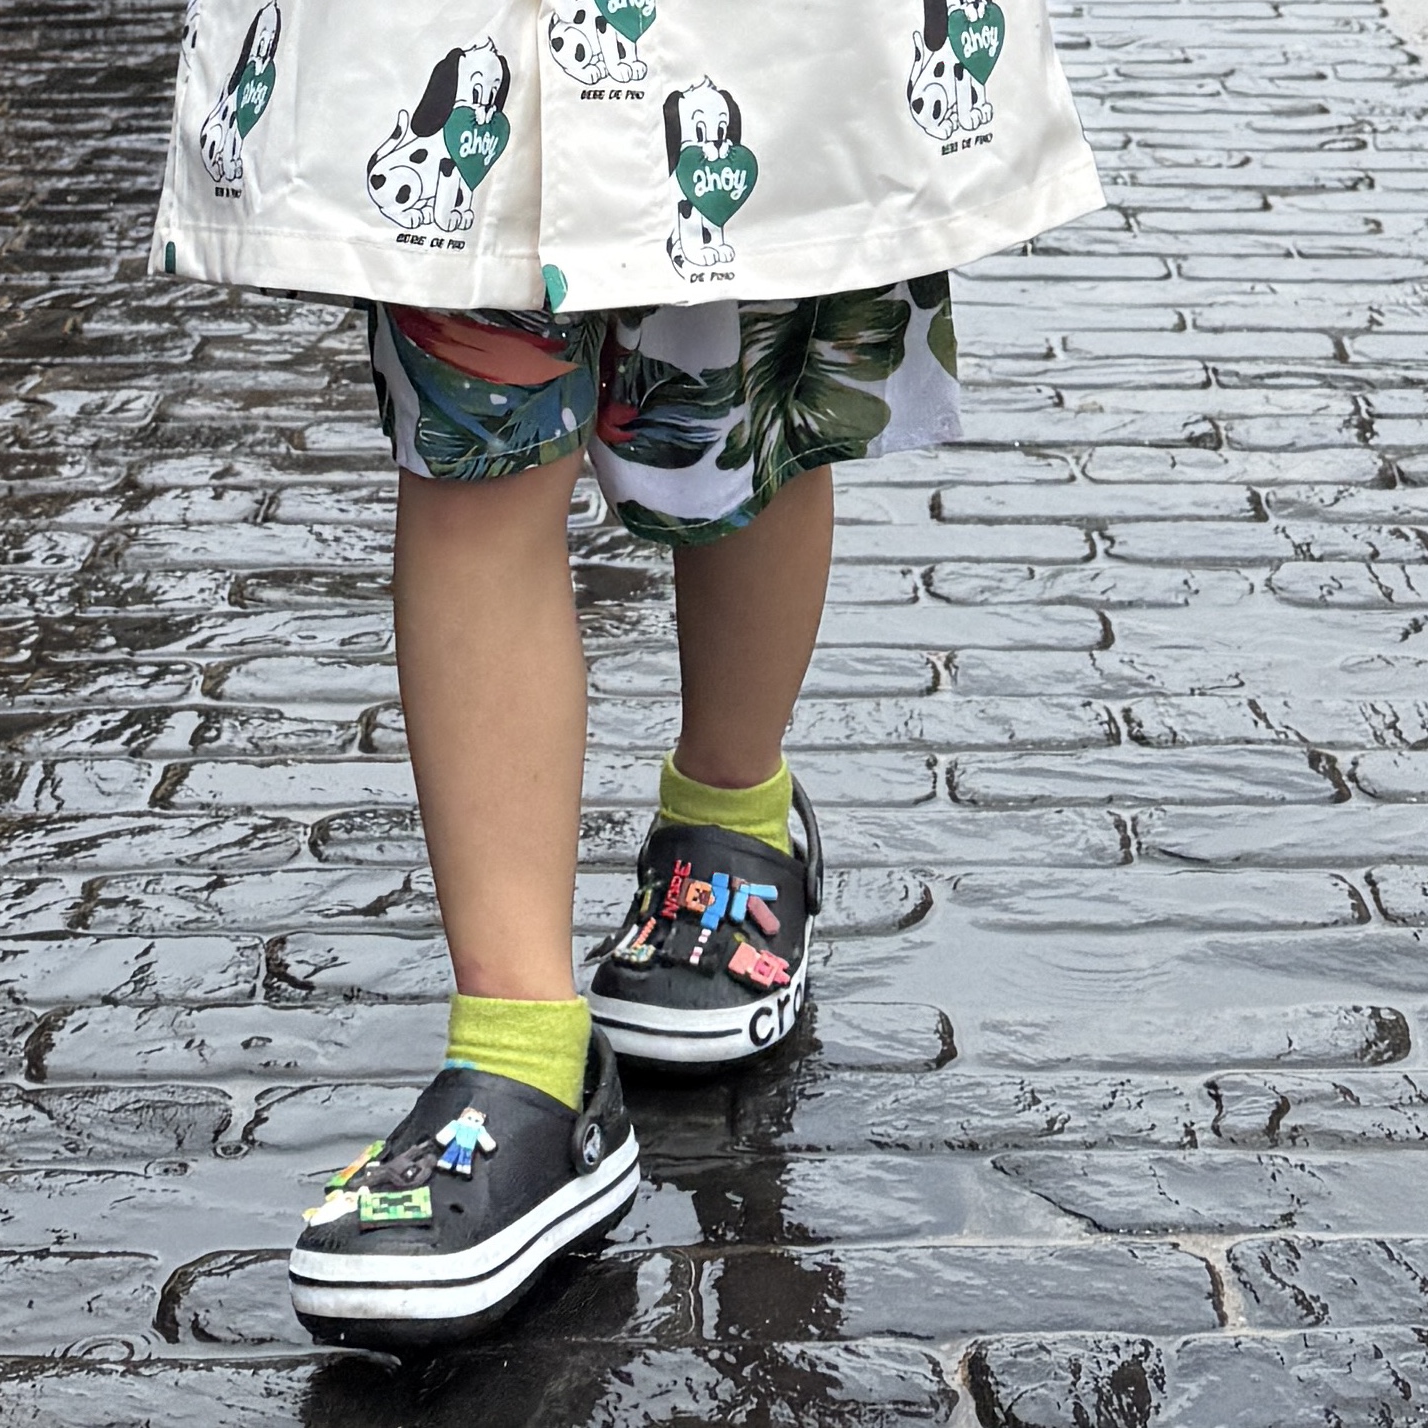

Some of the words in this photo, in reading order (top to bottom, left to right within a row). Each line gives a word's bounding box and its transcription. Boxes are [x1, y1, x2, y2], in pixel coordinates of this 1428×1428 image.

[960, 25, 1000, 59] ahoy
[240, 79, 269, 115] ahoy
[459, 128, 499, 166] ahoy
[693, 165, 748, 201] ahoy
